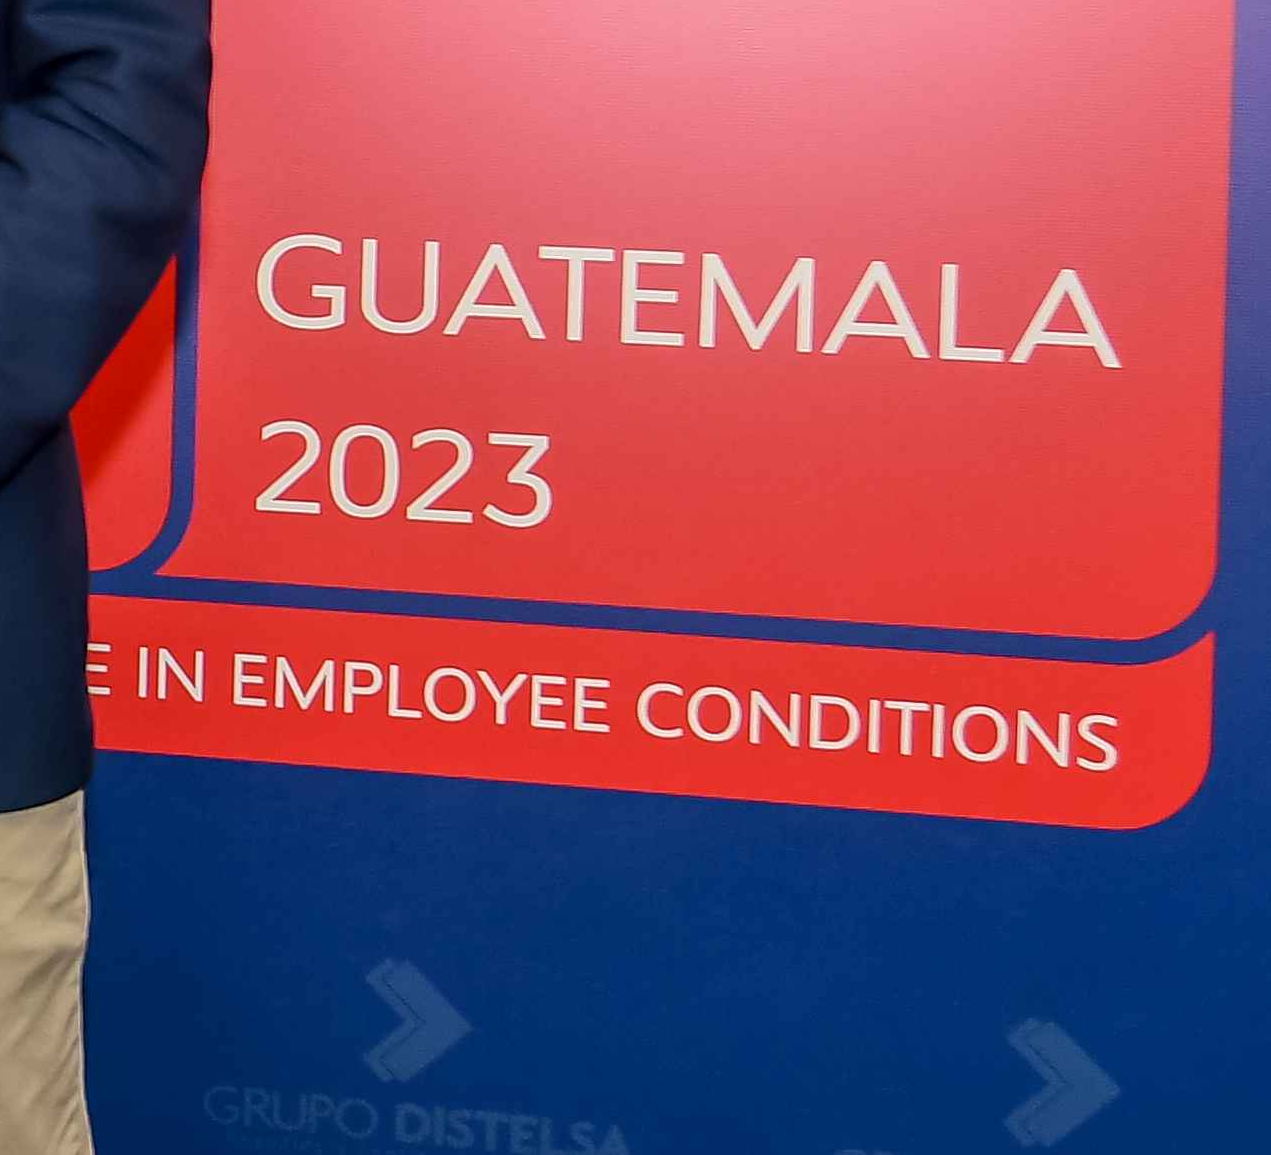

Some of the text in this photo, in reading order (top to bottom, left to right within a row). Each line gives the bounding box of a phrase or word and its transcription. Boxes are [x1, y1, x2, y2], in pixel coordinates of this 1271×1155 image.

[257, 233, 1123, 370] GUATEMALA
[256, 420, 554, 528] 2023
[136, 645, 205, 703] IN
[231, 653, 611, 735] EMPLOYEE
[636, 682, 1118, 771] CONDITIONS
[204, 1085, 379, 1139] GRUPO
